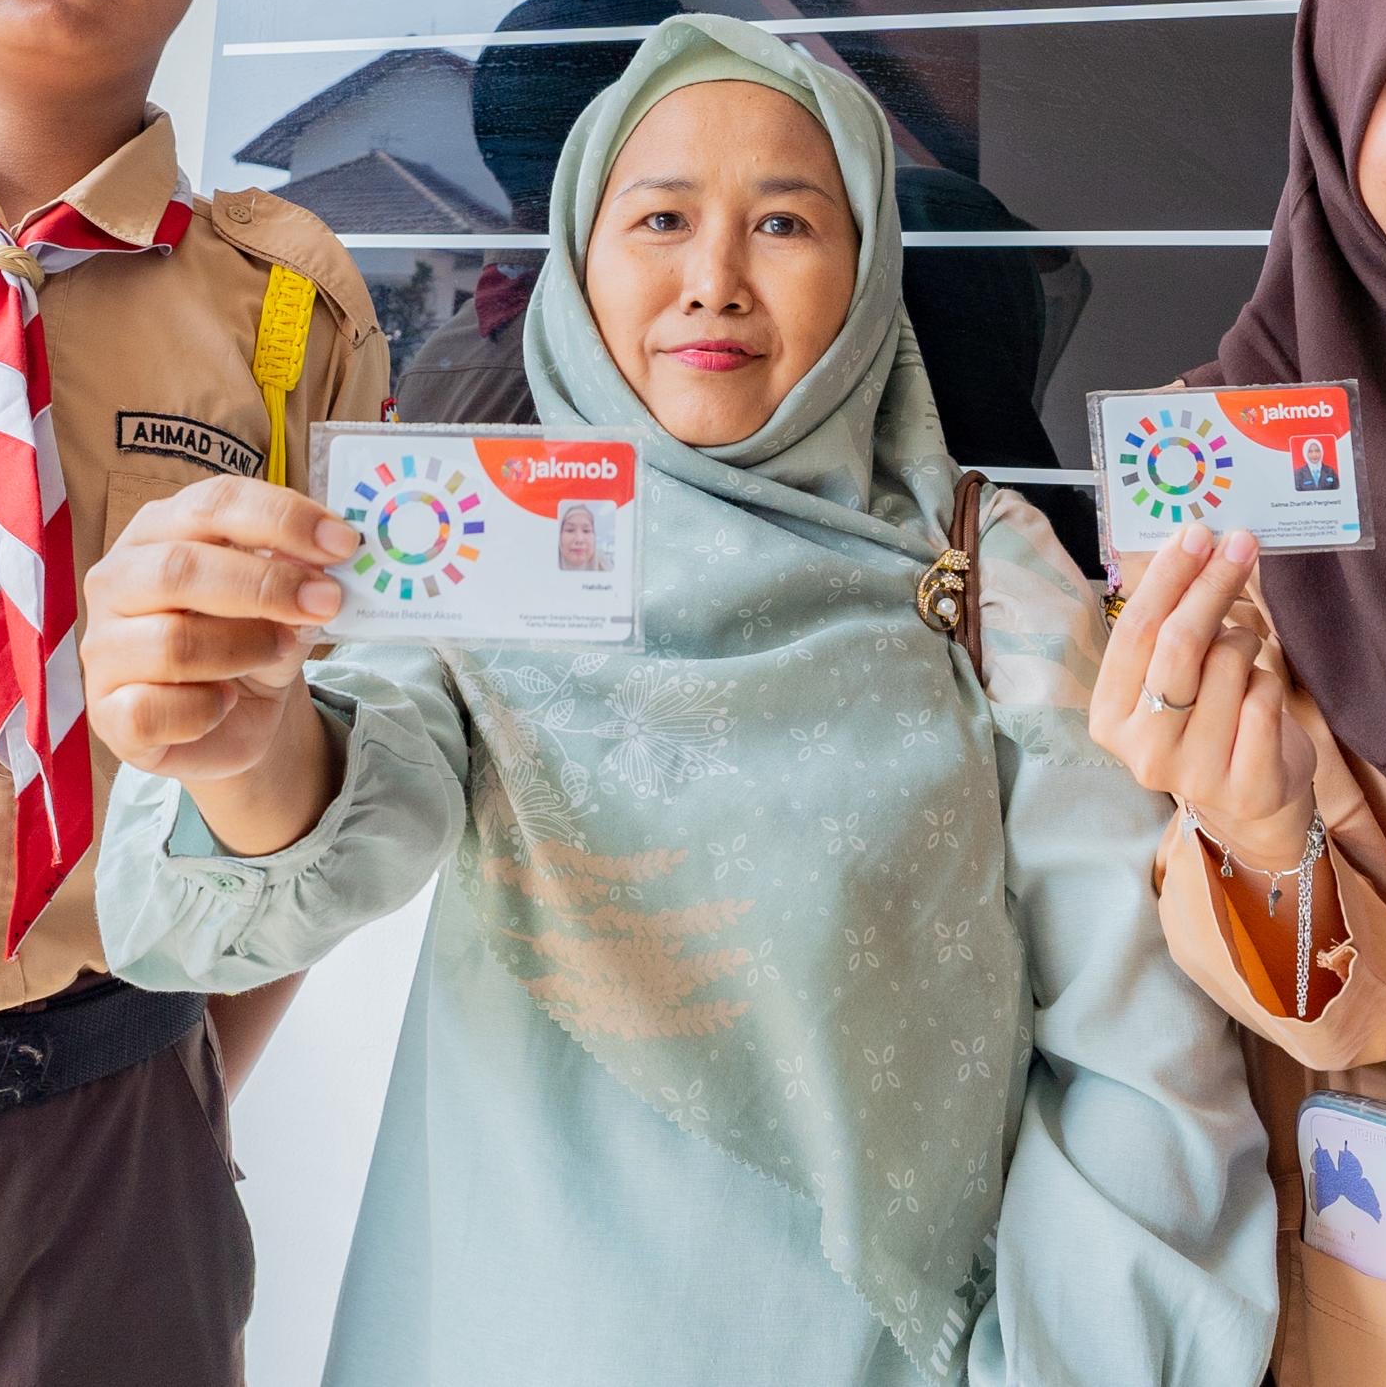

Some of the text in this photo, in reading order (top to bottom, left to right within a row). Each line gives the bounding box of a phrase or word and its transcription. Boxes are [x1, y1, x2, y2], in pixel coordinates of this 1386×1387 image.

[1260, 401, 1333, 425] jakmob
[133, 421, 211, 455] AHMAD
[527, 456, 618, 482] jakmob
[356, 609, 462, 620] Mobilitas Bebas Akses
